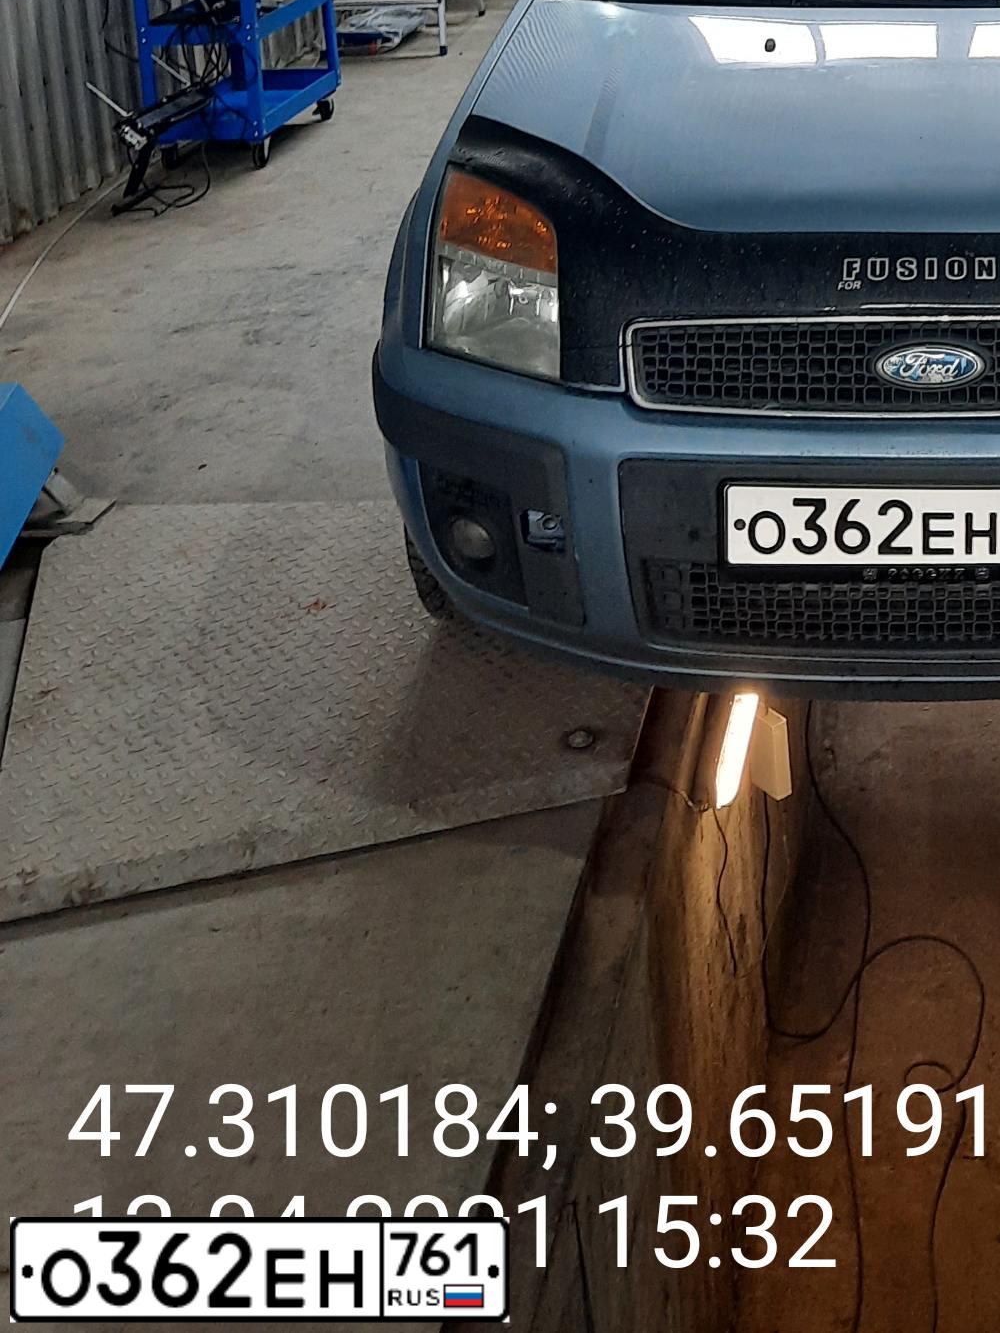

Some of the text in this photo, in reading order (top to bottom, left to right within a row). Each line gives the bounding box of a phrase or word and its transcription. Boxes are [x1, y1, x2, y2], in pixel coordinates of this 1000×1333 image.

[842, 256, 997, 281] FUSION
[899, 352, 958, 378] Ford
[747, 497, 998, 555] О362ЕН
